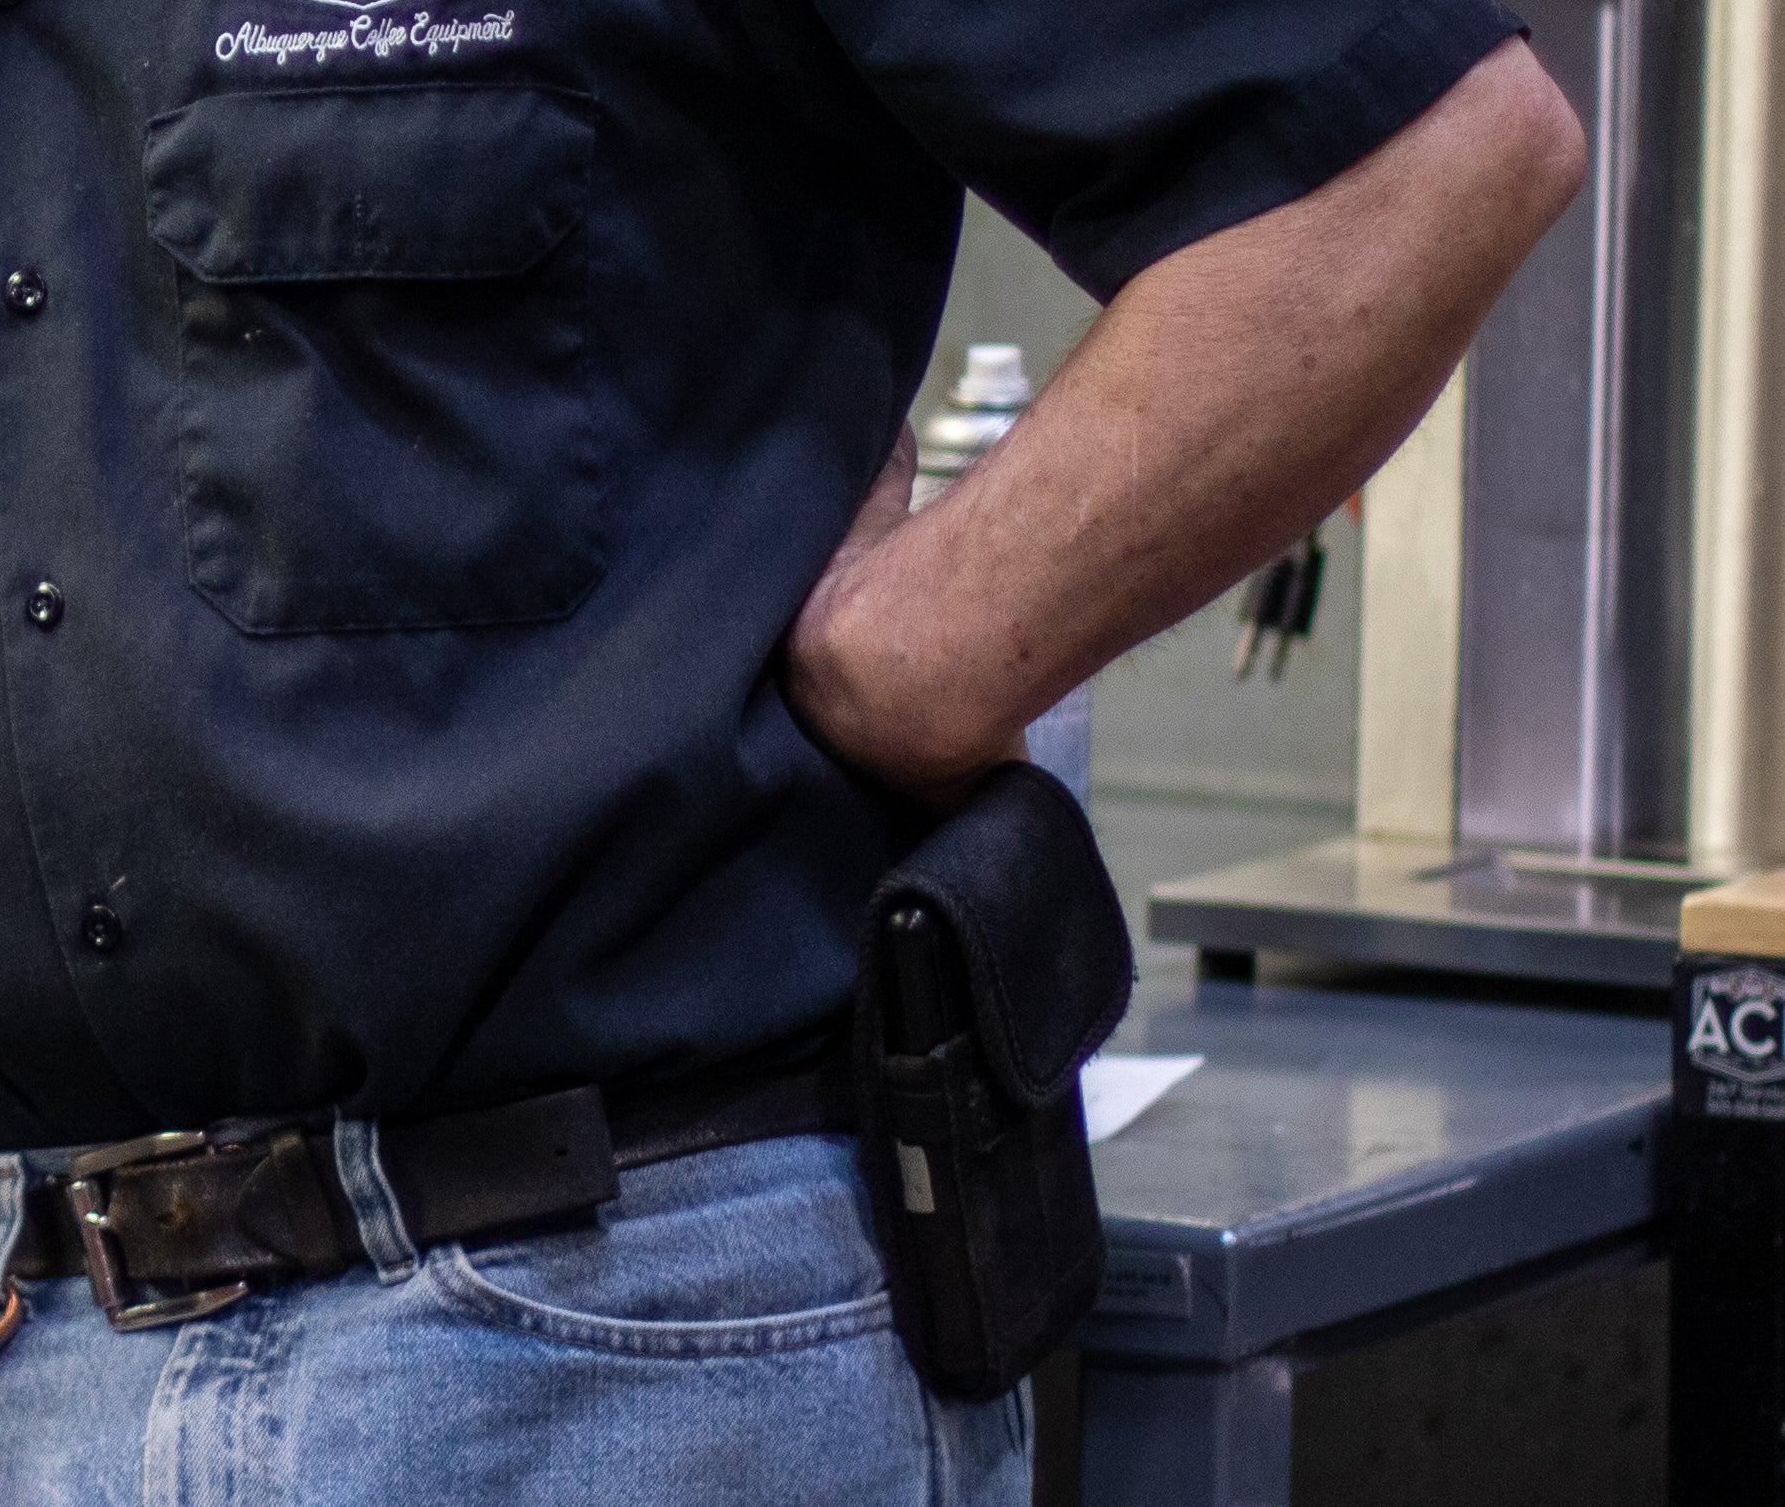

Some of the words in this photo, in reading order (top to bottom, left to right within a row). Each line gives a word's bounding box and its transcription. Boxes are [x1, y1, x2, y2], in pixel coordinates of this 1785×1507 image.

[215, 21, 349, 65] Albuquerque
[350, 14, 407, 57] Coffee
[410, 9, 515, 56] Equipment
